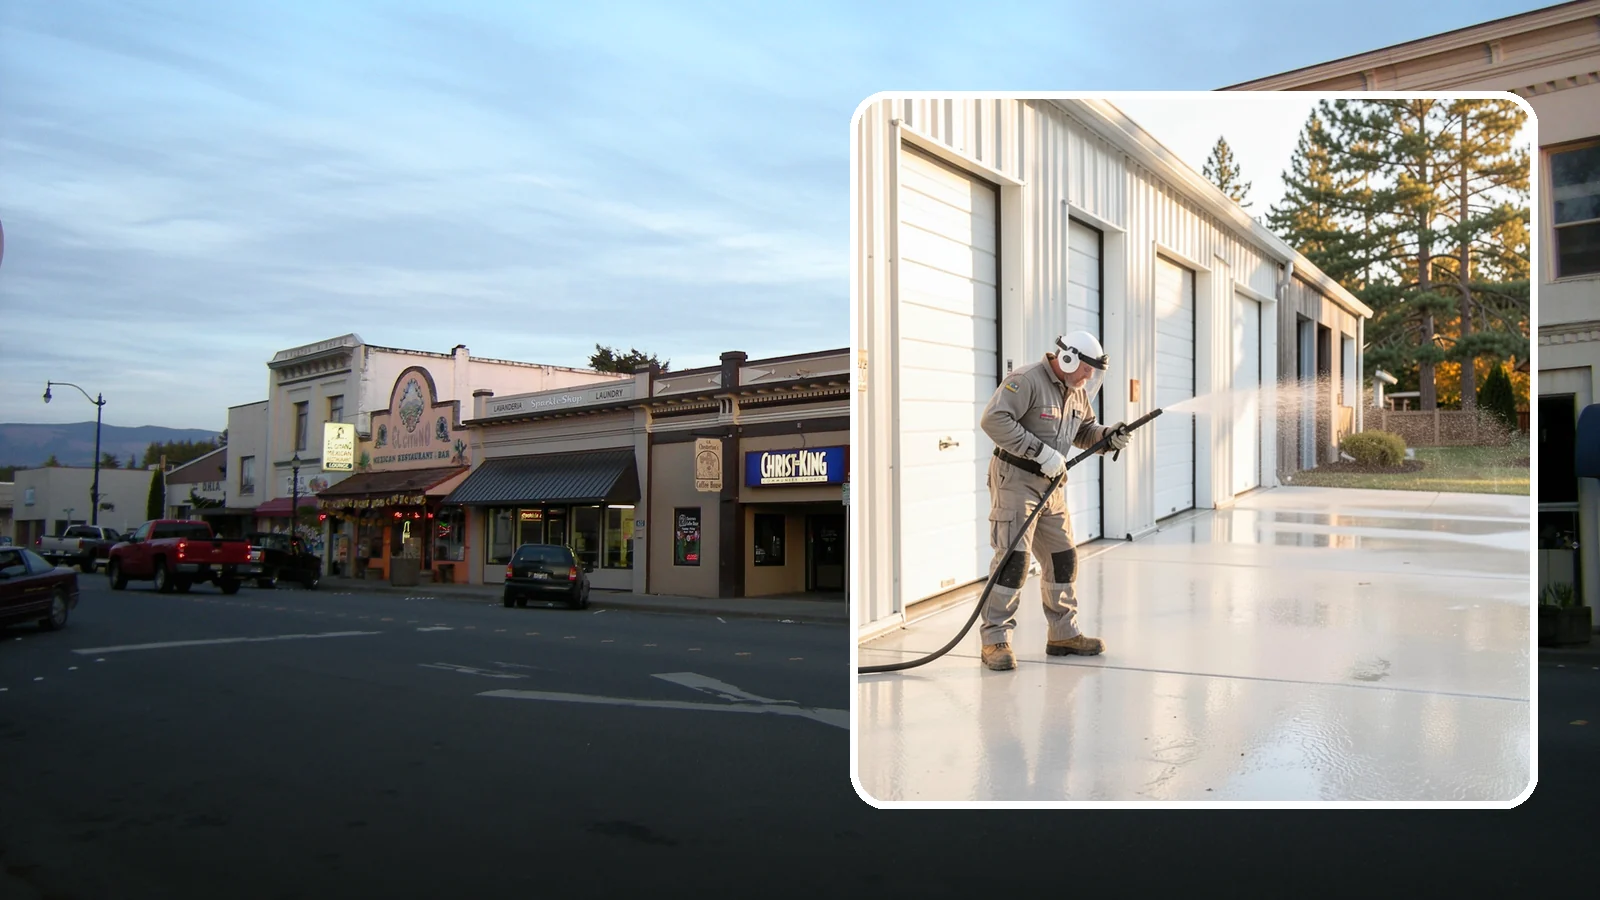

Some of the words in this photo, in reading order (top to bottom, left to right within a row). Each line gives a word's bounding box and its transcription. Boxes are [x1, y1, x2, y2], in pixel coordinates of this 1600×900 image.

[531, 396, 560, 409] Sparkle
[562, 394, 582, 406] Shop
[596, 389, 623, 400] LAUNDRY
[493, 402, 522, 412] LAVANDERIA
[374, 455, 396, 464] MEXICAN
[397, 452, 434, 462] RESTAURANT
[438, 450, 450, 459] BAR
[761, 452, 797, 478] CHRIST
[799, 450, 828, 476] KING
